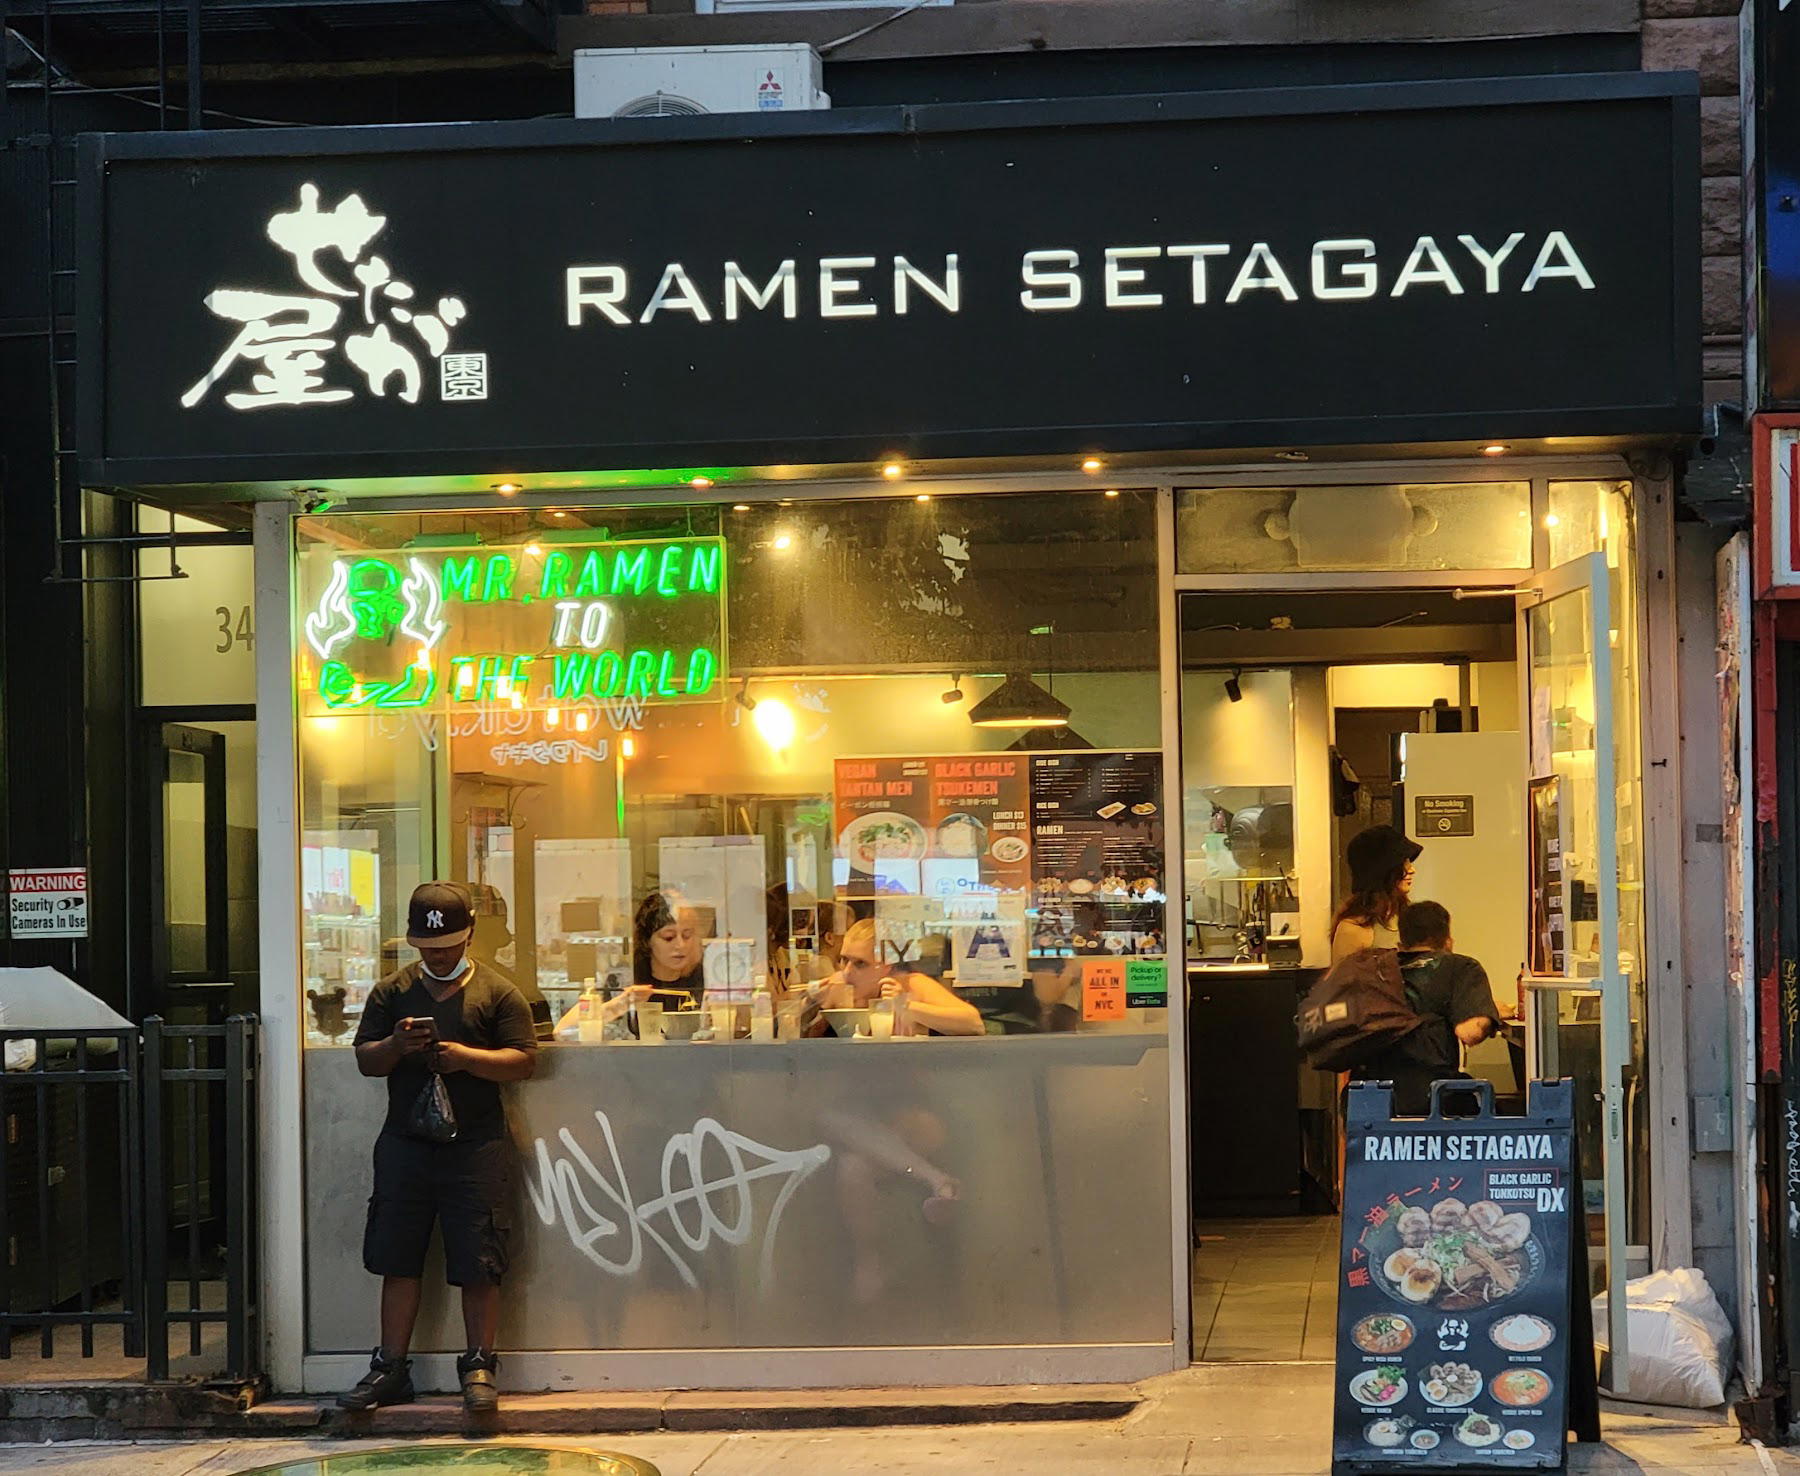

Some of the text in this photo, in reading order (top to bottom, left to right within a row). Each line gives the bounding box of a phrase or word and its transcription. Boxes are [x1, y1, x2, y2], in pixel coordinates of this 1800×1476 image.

[566, 231, 1596, 326] RAMEN SETAGAYA
[539, 545, 720, 598] RAMEN
[553, 601, 610, 650] TO
[553, 648, 718, 699] WORLD
[1036, 825, 1064, 835] RAMEN
[9, 875, 87, 891] WARNING
[12, 897, 54, 914] Security
[12, 914, 86, 929] Cameras In Use
[1130, 967, 1154, 975] Pickup
[1089, 977, 1120, 987] ALL IN
[1095, 1000, 1114, 1010] NYC
[1364, 1134, 1554, 1162] RAMEN SETAGAYA
[1489, 1172, 1552, 1185] BLACK GARLIC
[1489, 1187, 1566, 1213] TONKOTSU DX
